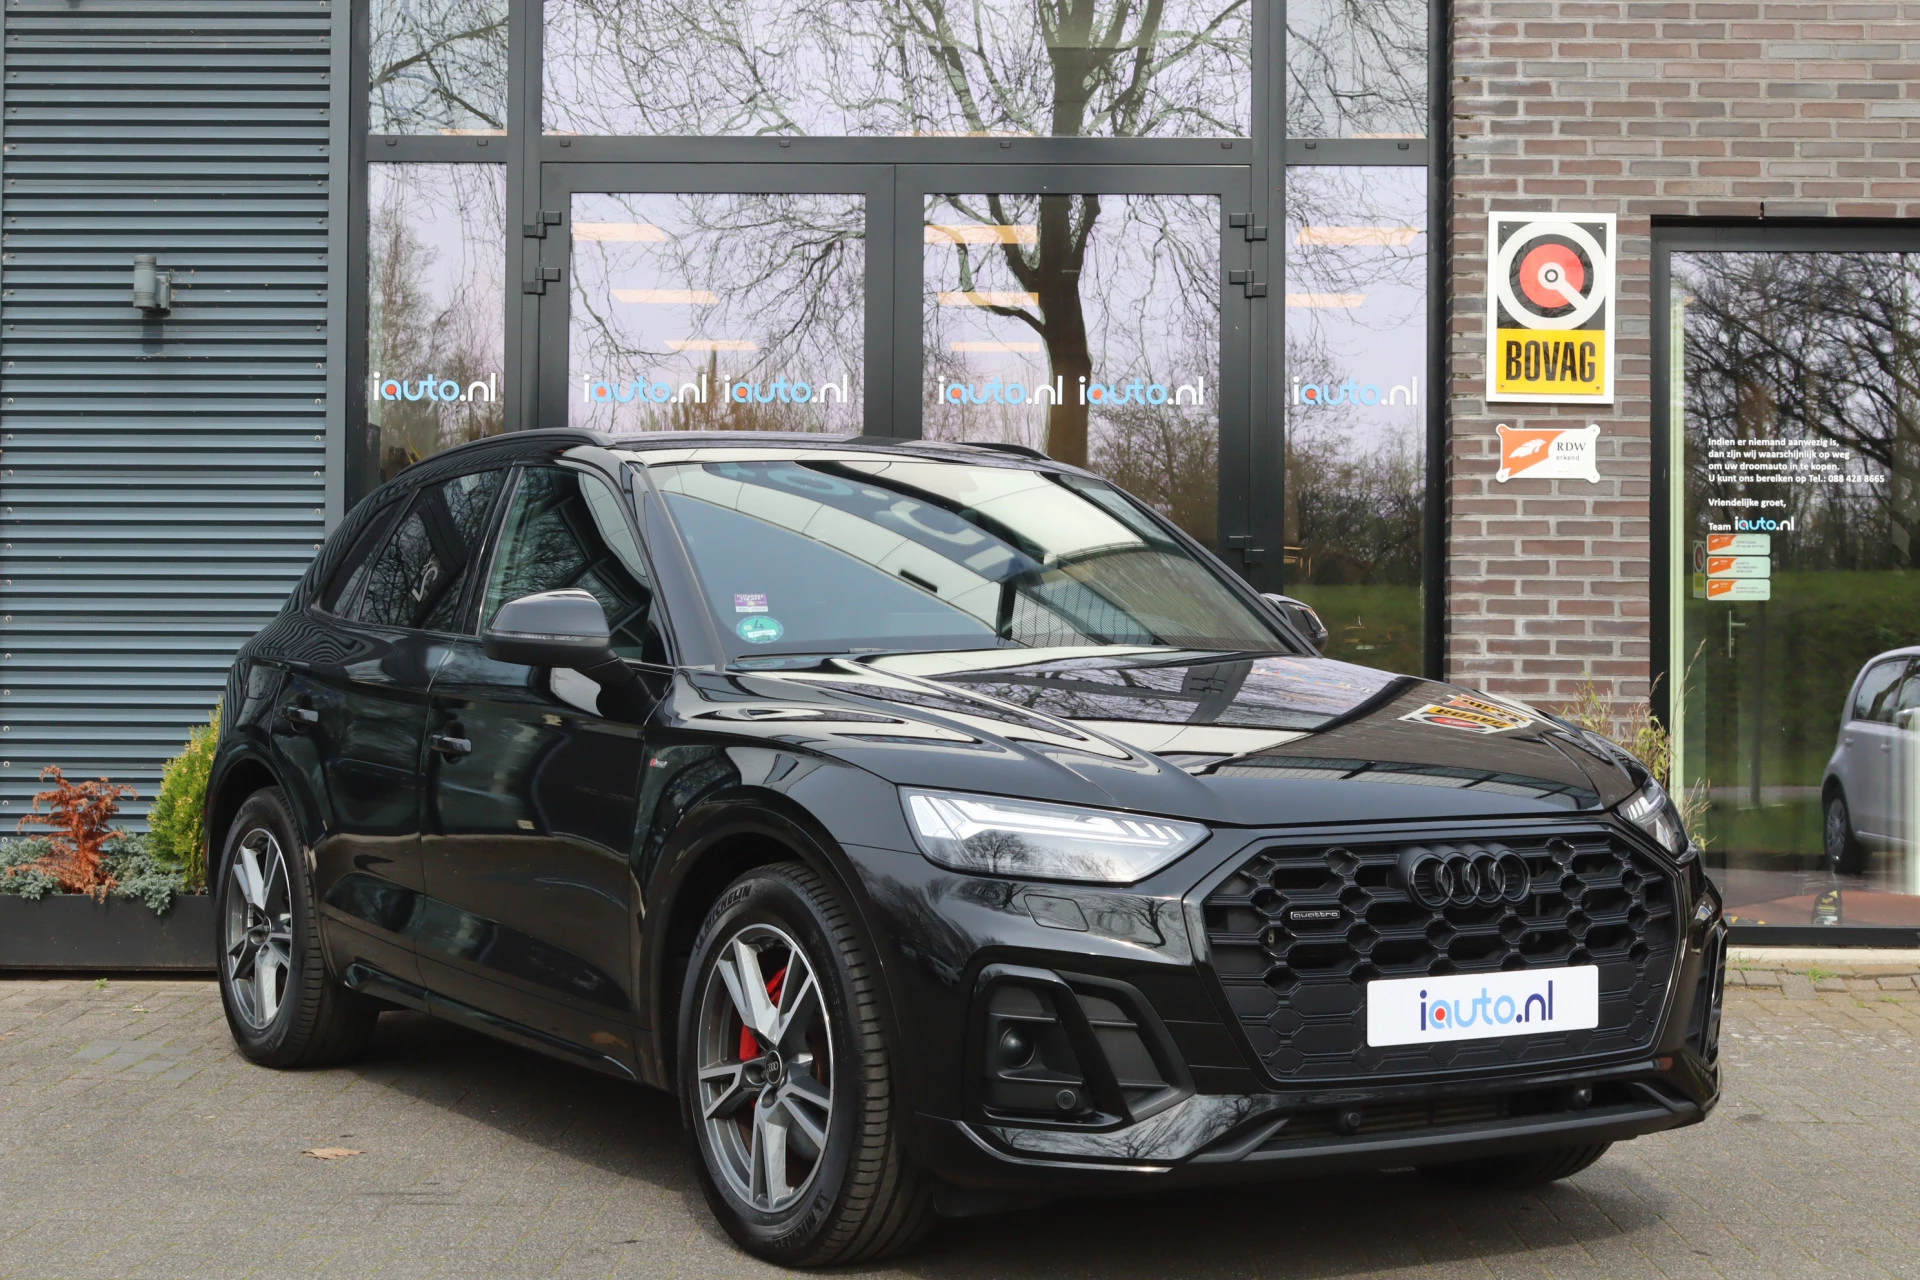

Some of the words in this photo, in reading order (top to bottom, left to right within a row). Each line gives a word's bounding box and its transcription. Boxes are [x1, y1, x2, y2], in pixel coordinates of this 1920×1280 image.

[1505, 340, 1597, 382] BOVAG
[373, 372, 496, 401] iauto.nl
[583, 373, 707, 403] iauto.nl
[724, 373, 848, 403] iauto.nl
[938, 375, 1063, 405] iauto.nl
[1079, 375, 1204, 405] iauto.nl
[1293, 376, 1418, 406] iauto.nl
[1557, 442, 1586, 452] RDW
[1708, 438, 1735, 446] Indien
[1748, 438, 1786, 446] niemand
[1788, 438, 1828, 448] aanwezig
[1829, 438, 1840, 447] is,
[1708, 449, 1725, 458] dan
[1726, 449, 1741, 460] zijn
[1743, 449, 1757, 460] wij
[1758, 449, 1817, 460] waarschijnlijk
[1819, 451, 1830, 460] op
[1832, 451, 1850, 460] weg
[1708, 474, 1715, 482] U
[1717, 474, 1737, 482] kunt
[1756, 474, 1793, 482] bereiken
[1795, 475, 1806, 484] op
[1809, 474, 1826, 482] Tel.:
[1828, 474, 1844, 483] 088
[1846, 474, 1862, 483] 428
[1864, 474, 1885, 483] 8665
[1740, 462, 1787, 470] droomauto
[1789, 462, 1798, 470] in
[1811, 462, 1840, 472] kopen.
[1708, 498, 1759, 508] Vriendelijke
[1760, 499, 1787, 508] groet,
[1708, 522, 1732, 531] Team
[1734, 516, 1794, 531] iauto.nl
[704, 885, 753, 934] MICHELIN
[1293, 911, 1339, 920] quattro
[1420, 980, 1553, 1031] iauto.nl
